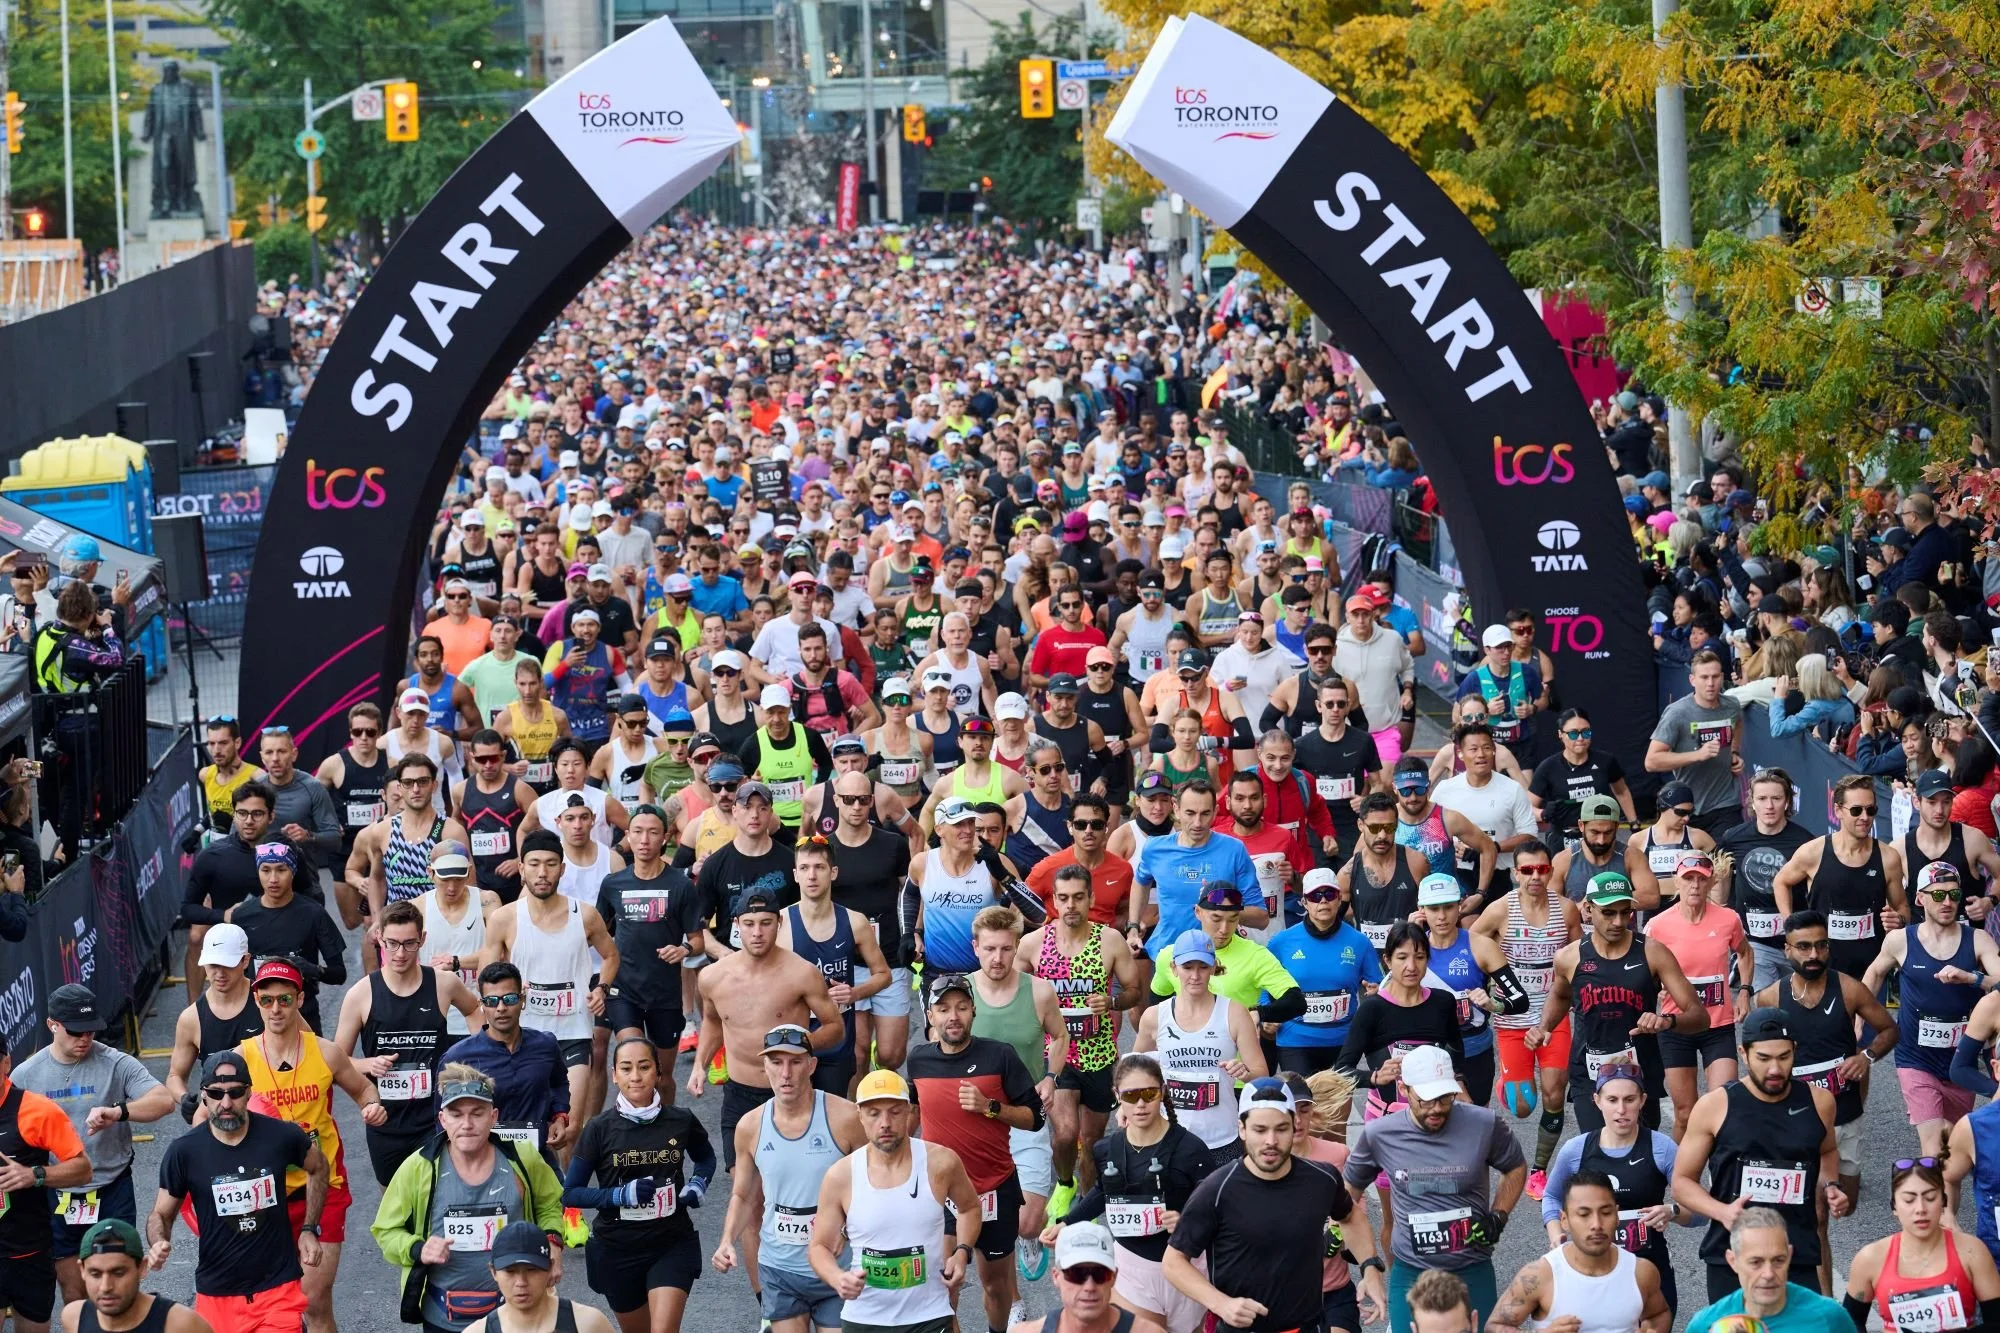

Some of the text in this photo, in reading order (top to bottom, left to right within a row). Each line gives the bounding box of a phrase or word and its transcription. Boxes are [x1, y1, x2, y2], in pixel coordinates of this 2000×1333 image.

[579, 91, 611, 110] tcs
[1176, 86, 1207, 104] tcs
[579, 111, 684, 127] TORONTO
[1174, 106, 1278, 121] TORONTO
[1314, 172, 1532, 402] START
[351, 172, 545, 432] START
[1494, 435, 1575, 485] tcs
[757, 470, 781, 482] 3:10
[306, 459, 386, 510] tcs
[1531, 555, 1589, 572] TATA
[293, 581, 351, 598] TATA
[1545, 607, 1579, 616] CHOOSE
[1545, 615, 1604, 653] TO
[1585, 652, 1602, 660] RUN
[351, 810, 371, 819] 1543
[473, 840, 492, 848] 5860
[1652, 857, 1675, 865] 3288
[623, 904, 649, 913] 10940
[1749, 920, 1771, 929] 3734
[1832, 920, 1857, 928] 5389
[261, 966, 289, 976] GUARD
[1518, 976, 1542, 984] 1578
[530, 997, 555, 1007] 6737
[1580, 983, 1643, 1011] Braves
[1307, 1004, 1332, 1013] 5890
[1922, 1028, 1949, 1038] 3736
[377, 1035, 437, 1045] BLACKTOE
[1166, 1046, 1221, 1058] TORONTO
[1169, 1060, 1219, 1069] HARRIERS
[380, 1079, 408, 1089] 4856
[1169, 1088, 1197, 1099] 19279
[1747, 1177, 1780, 1190] 1943
[218, 1190, 252, 1204] 6134
[1110, 1214, 1141, 1225] 3378
[448, 1225, 474, 1235] 825
[778, 1222, 809, 1234] 6174
[1414, 1230, 1450, 1244] 11631
[866, 1265, 899, 1278] 1524
[1898, 1308, 1933, 1324] 6349
